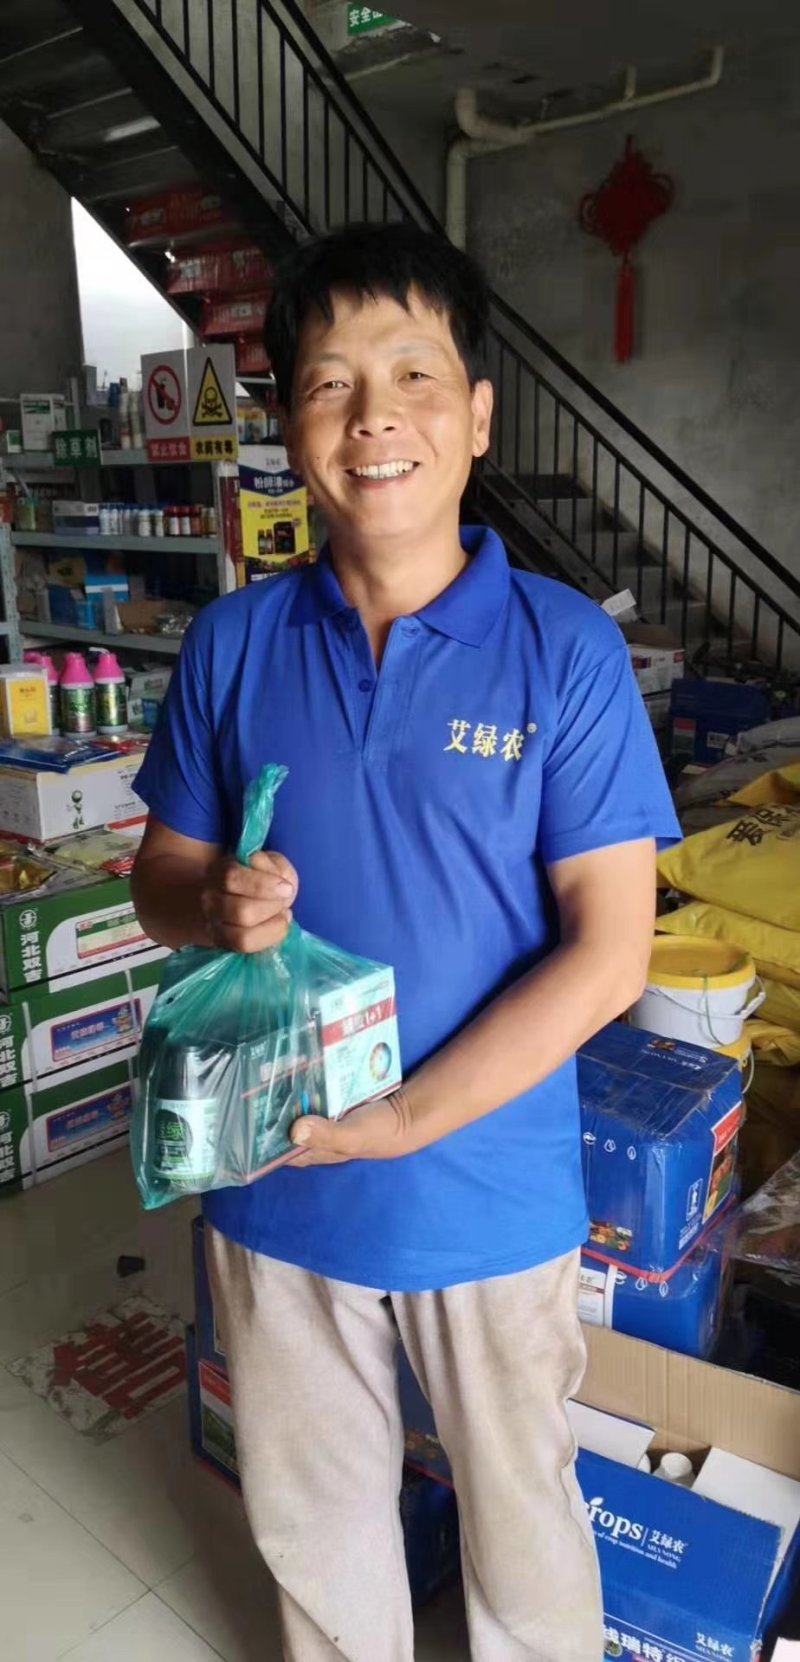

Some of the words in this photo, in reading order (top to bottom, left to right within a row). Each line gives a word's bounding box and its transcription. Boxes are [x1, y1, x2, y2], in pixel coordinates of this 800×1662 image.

[55, 435, 98, 460] 除草剂
[151, 442, 187, 458] 禁止饮食
[195, 440, 233, 456] 农药有毒
[443, 719, 525, 762] 艾绿农
[20, 930, 42, 984] 河北双吉
[583, 1501, 644, 1541] rops
[649, 1529, 684, 1554] 艾绿农
